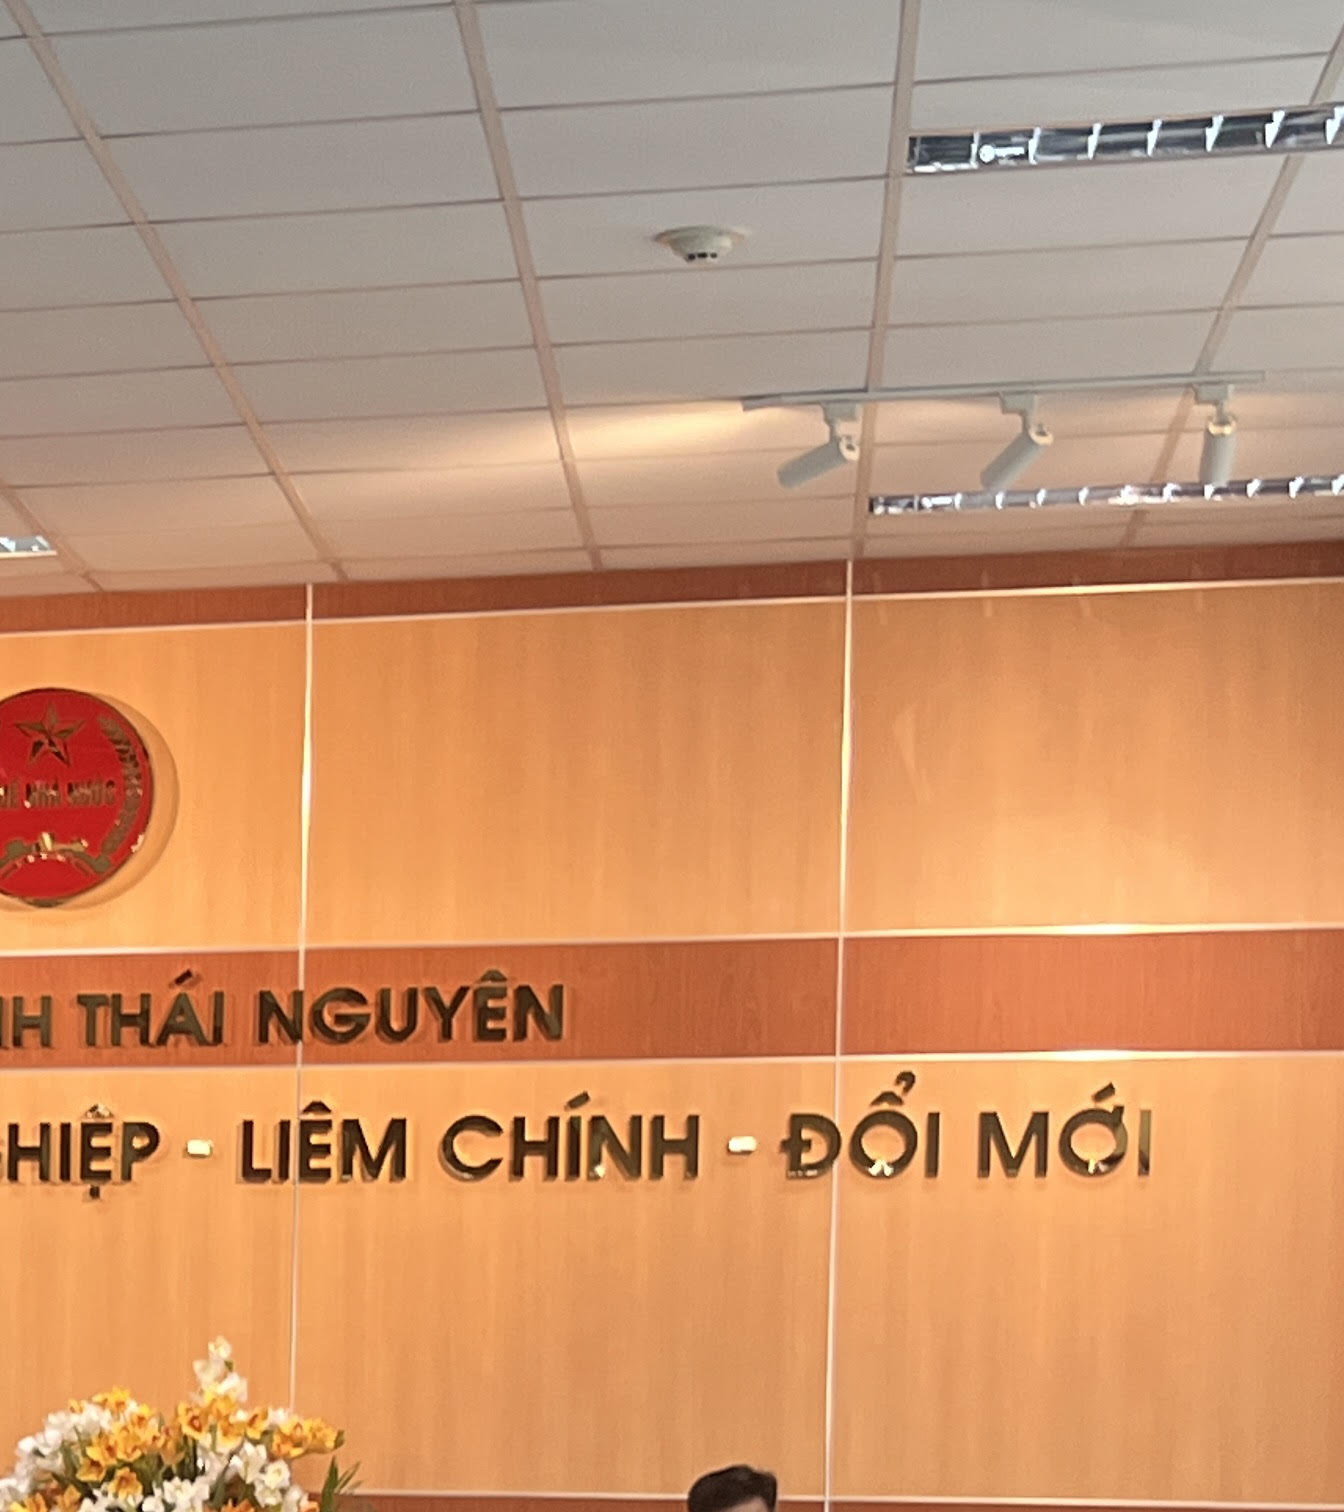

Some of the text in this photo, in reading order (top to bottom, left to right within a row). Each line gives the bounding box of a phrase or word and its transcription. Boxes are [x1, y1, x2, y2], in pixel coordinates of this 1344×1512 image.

[77, 969, 226, 1047] THÁI
[258, 969, 566, 1044] NGUYÊN
[239, 1101, 408, 1182] LIÊM
[440, 1091, 700, 1180] CHÍNH
[781, 1071, 941, 1180] ĐỔI
[977, 1082, 1153, 1178] MỚI
